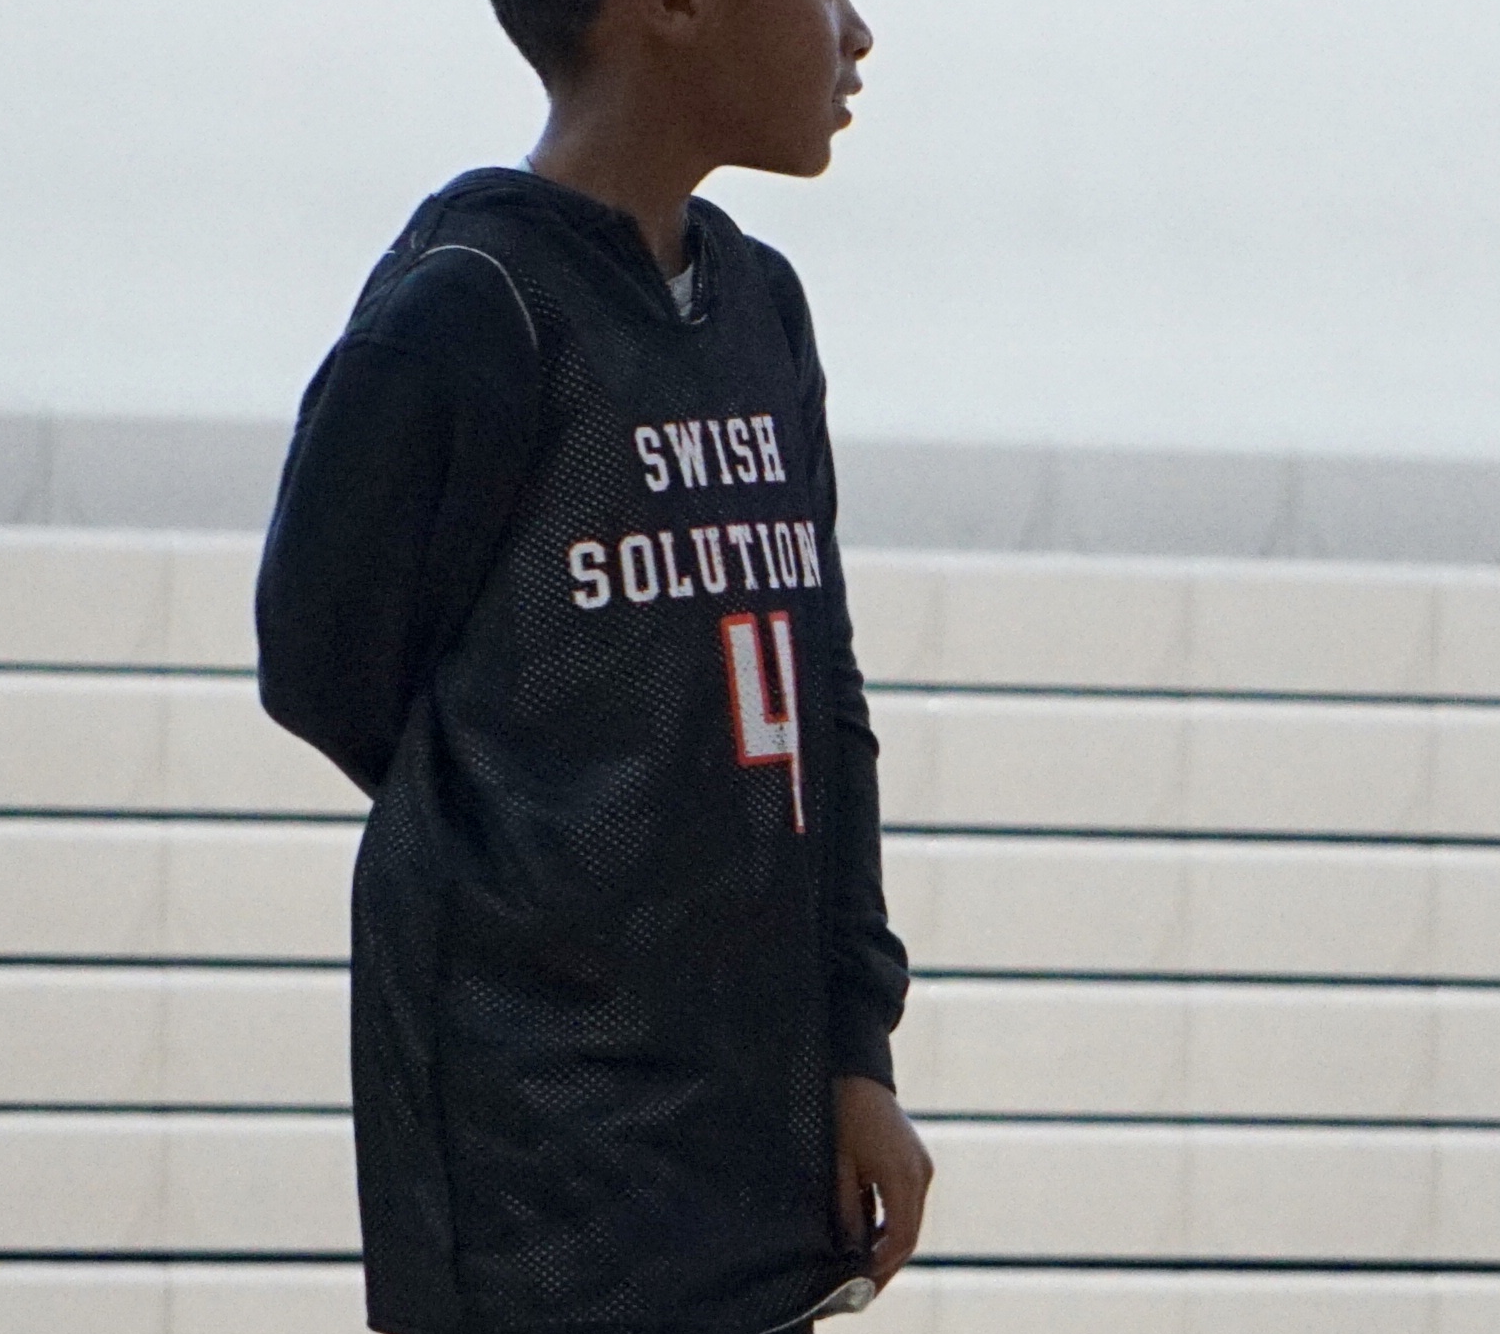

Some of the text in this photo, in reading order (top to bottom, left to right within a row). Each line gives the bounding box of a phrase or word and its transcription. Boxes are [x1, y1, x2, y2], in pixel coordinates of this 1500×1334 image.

[633, 412, 787, 493] SWISH
[567, 519, 824, 610] SOLUTION
[720, 610, 807, 834] 4
